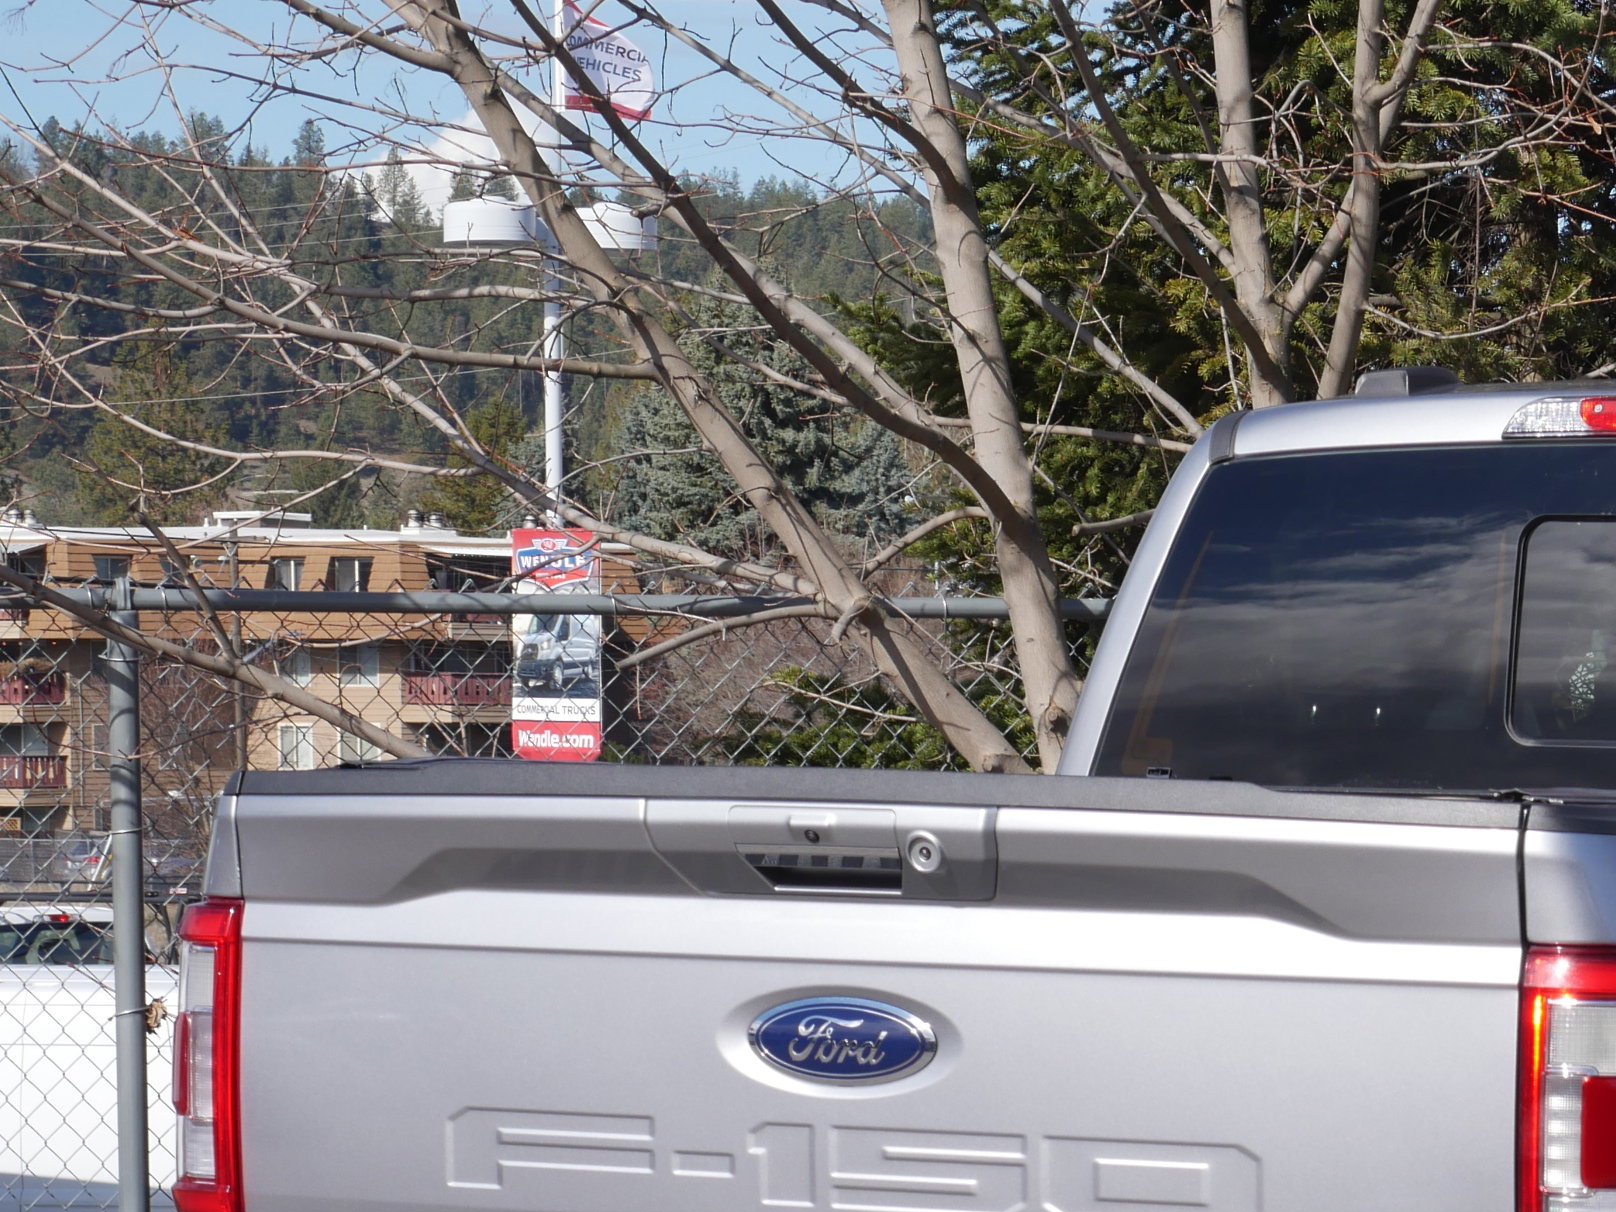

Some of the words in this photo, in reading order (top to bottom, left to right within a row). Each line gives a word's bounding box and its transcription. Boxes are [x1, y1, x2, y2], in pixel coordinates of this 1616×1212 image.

[517, 704, 560, 715] COMMERCAL
[562, 705, 596, 715] TRUCKS
[518, 729, 594, 748] Wendle.com
[788, 1015, 888, 1066] Ford
